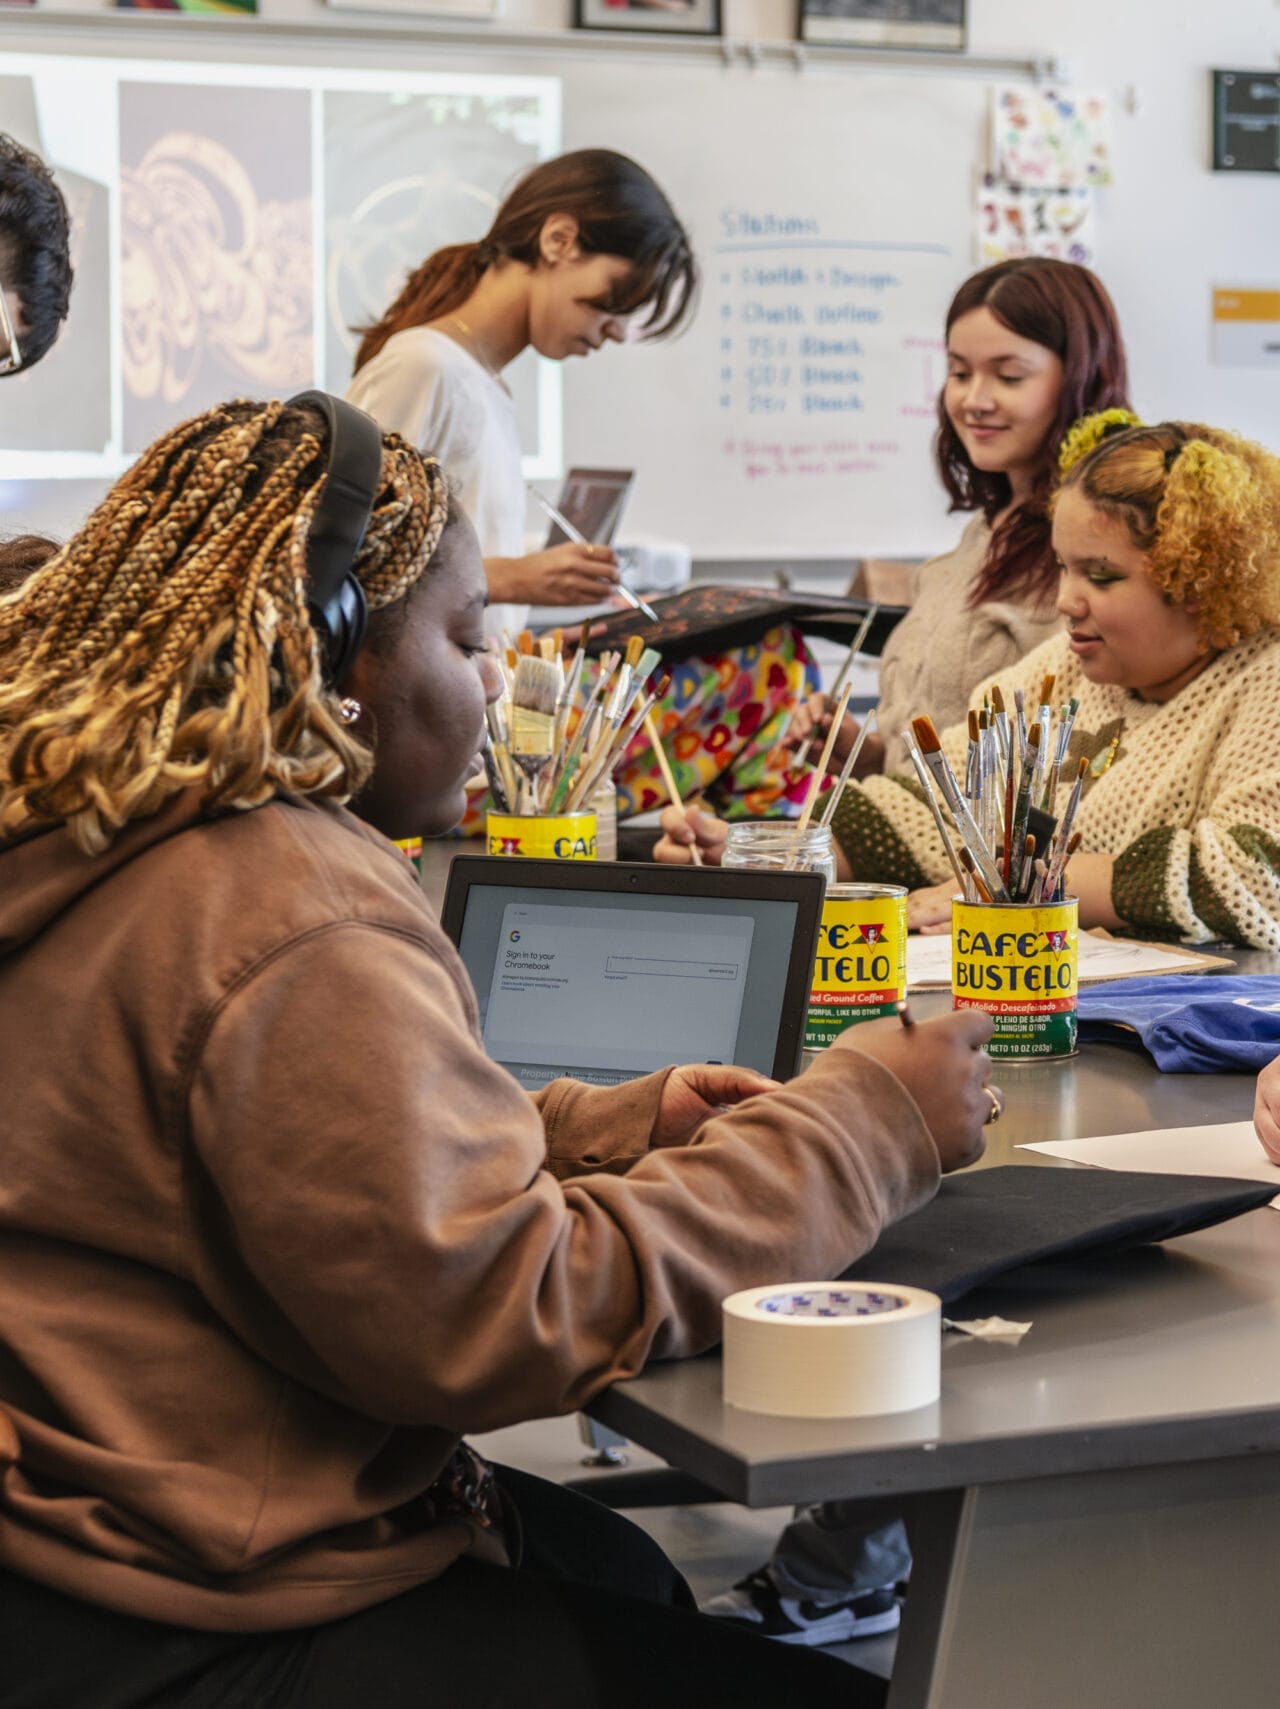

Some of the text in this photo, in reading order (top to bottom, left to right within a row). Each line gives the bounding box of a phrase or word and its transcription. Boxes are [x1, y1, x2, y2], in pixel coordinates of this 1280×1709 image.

[800, 336, 864, 356] Bleach
[801, 366, 863, 386] Bleach
[801, 395, 864, 415] Bleach
[505, 950, 521, 960] Sign
[539, 953, 555, 961] your
[504, 960, 550, 970] Chromebook
[815, 955, 890, 983] TELO
[956, 961, 1072, 991] BUSTELO
[823, 993, 856, 1003] Ground
[857, 992, 884, 1004] Coffee
[861, 1008, 881, 1016] OTHER
[970, 1001, 999, 1011] Molido
[1000, 1002, 1056, 1013] Descafeinado
[995, 1015, 1018, 1023] PLENO
[1019, 1015, 1028, 1023] DE
[1028, 1023, 1046, 1032] OTRO
[805, 1033, 816, 1041] WT
[817, 1033, 826, 1042] 10
[990, 1043, 1009, 1053] NETO
[1010, 1044, 1019, 1053] 10
[1020, 1044, 1031, 1053] OZ
[520, 1068, 560, 1081] Property
